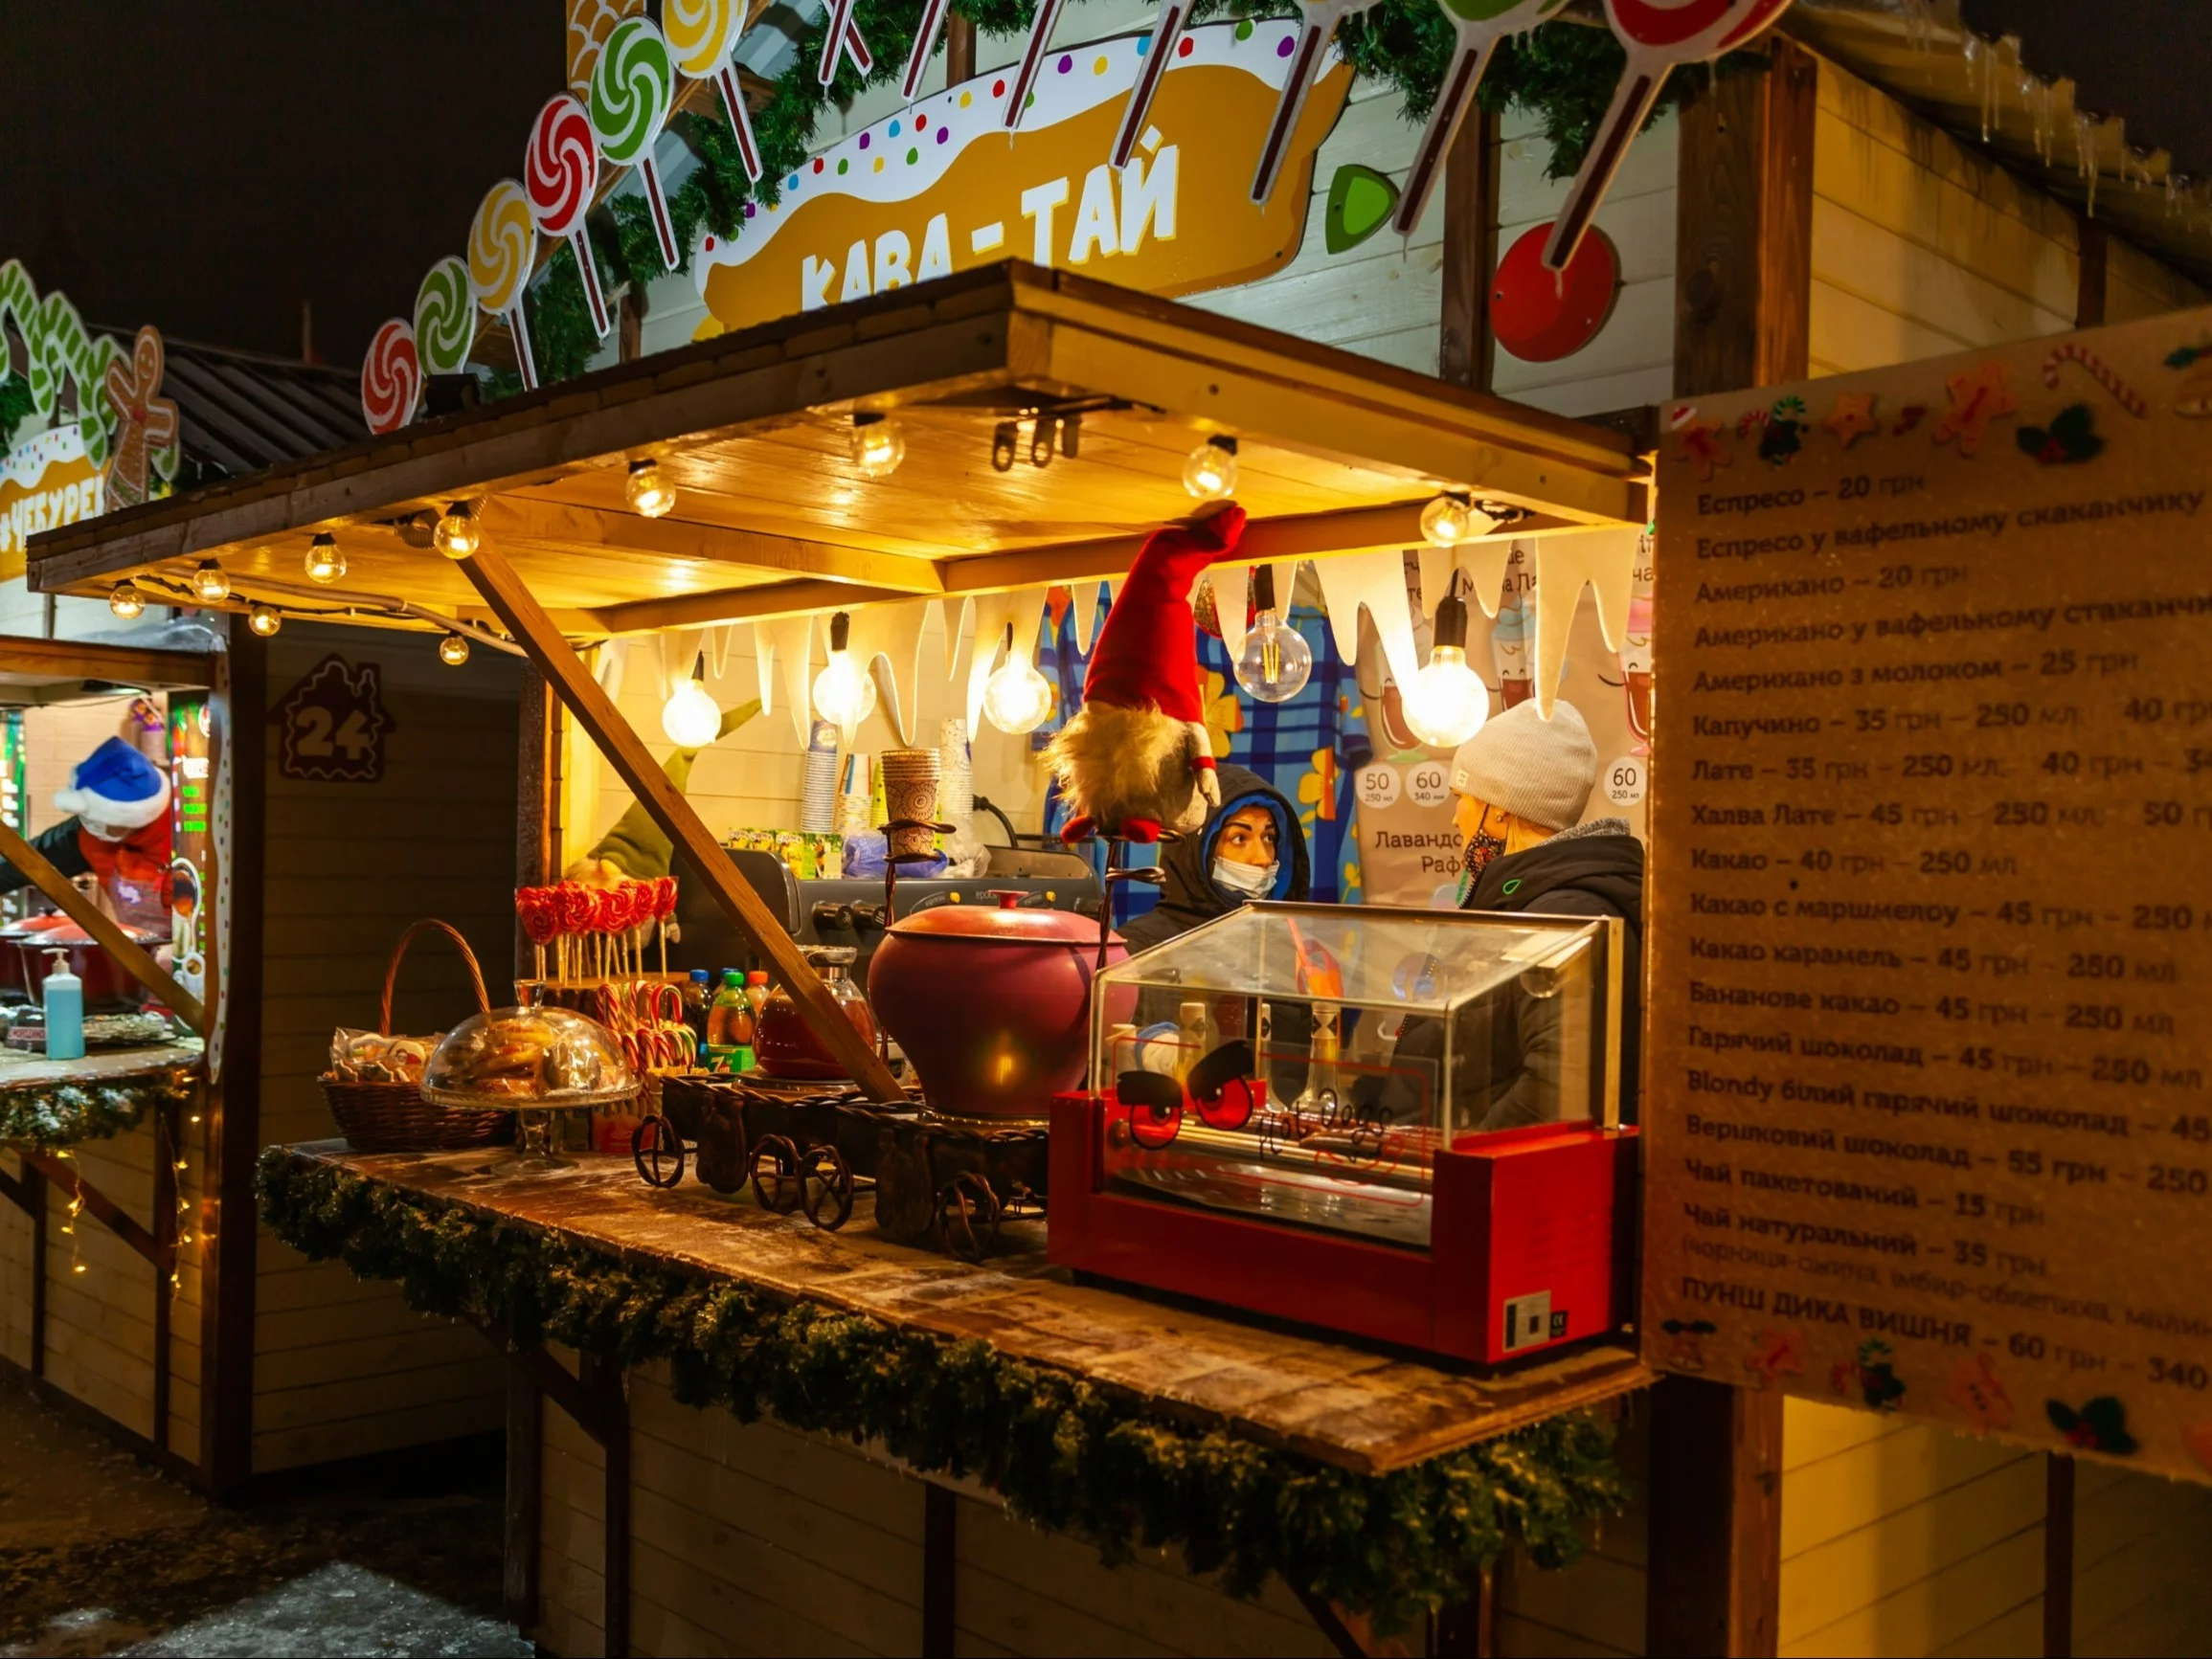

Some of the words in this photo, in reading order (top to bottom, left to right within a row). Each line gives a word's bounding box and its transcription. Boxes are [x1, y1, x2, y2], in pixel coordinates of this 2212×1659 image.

[802, 213, 954, 312] КАВА
[1021, 123, 1180, 268] ТАЙ
[1698, 488, 1804, 516] Еспресо
[1838, 477, 1870, 500] 20
[1697, 534, 1803, 560] Еспресо
[1835, 514, 2008, 548] вафельному
[1697, 576, 1844, 604] Американо
[1878, 564, 1912, 588] 20
[1695, 622, 1843, 649] Американо
[1876, 608, 2055, 639] вафельному
[1694, 669, 1842, 695] Американо
[1871, 661, 2002, 683] молоком
[2040, 650, 2075, 675] 25
[296, 706, 370, 760] 24
[1692, 715, 1821, 741] Капучино
[1854, 708, 1886, 730] 35
[1976, 703, 2030, 728] 250
[2124, 698, 2163, 723] 40
[2173, 701, 2212, 726] гр
[1366, 772, 1390, 791] 50
[1416, 771, 1442, 789] 60
[1613, 767, 1636, 787] 60
[1692, 760, 1753, 781] Лате
[1786, 757, 1816, 780] 35
[1903, 754, 1953, 777] 250
[2042, 751, 2080, 775] 40
[1612, 790, 1628, 799] 250
[1691, 804, 1766, 826] Халва
[1772, 803, 1836, 826] Лате
[1870, 802, 1904, 825] 45
[1994, 801, 2048, 826] 250
[2144, 800, 2183, 827] 50
[1375, 830, 1465, 850] Лавандо
[1690, 848, 1769, 871] Какао
[1800, 850, 1833, 872] 40
[1919, 850, 1973, 874] 250
[1690, 893, 1767, 917] Какао
[1996, 901, 2032, 926] 45
[2133, 905, 2193, 930] 250
[1689, 936, 1767, 961] Какао
[1773, 944, 1901, 969] карамель
[1937, 947, 1973, 973] 45
[2067, 953, 2124, 979] 250
[1689, 981, 1812, 1010] Бананове
[1820, 993, 1900, 1016] какао
[1936, 997, 1971, 1020] 45
[2065, 1003, 2122, 1030] 250
[1688, 1025, 1792, 1054] Гарячий
[1800, 1039, 1924, 1067] шоколад
[1959, 1046, 1994, 1070] 45
[2091, 1055, 2151, 1086] 250
[1687, 1069, 1772, 1102] Blondy
[1863, 1090, 1979, 1119] гарячий
[1988, 1104, 2130, 1138] шоколад
[2171, 1114, 2211, 1142] 45
[1686, 1114, 1835, 1150] Вершковий
[1844, 1135, 1971, 1170] шоколад
[2008, 1150, 2042, 1176] 55
[2147, 1164, 2209, 1195] 250
[1685, 1157, 1731, 1184] Чай
[1741, 1168, 1918, 1208] пакетований
[1954, 1193, 1985, 1218] 15
[1684, 1201, 1731, 1229] Чай
[1739, 1214, 1916, 1256] натуральний
[1953, 1240, 1987, 1267] 35
[1682, 1276, 1765, 1311] ПУНШ
[1772, 1291, 1849, 1324] ДИКА
[1860, 1306, 1971, 1347] ВИШНЯ
[2008, 1332, 2045, 1360] 60
[2147, 1356, 2209, 1391] 340
